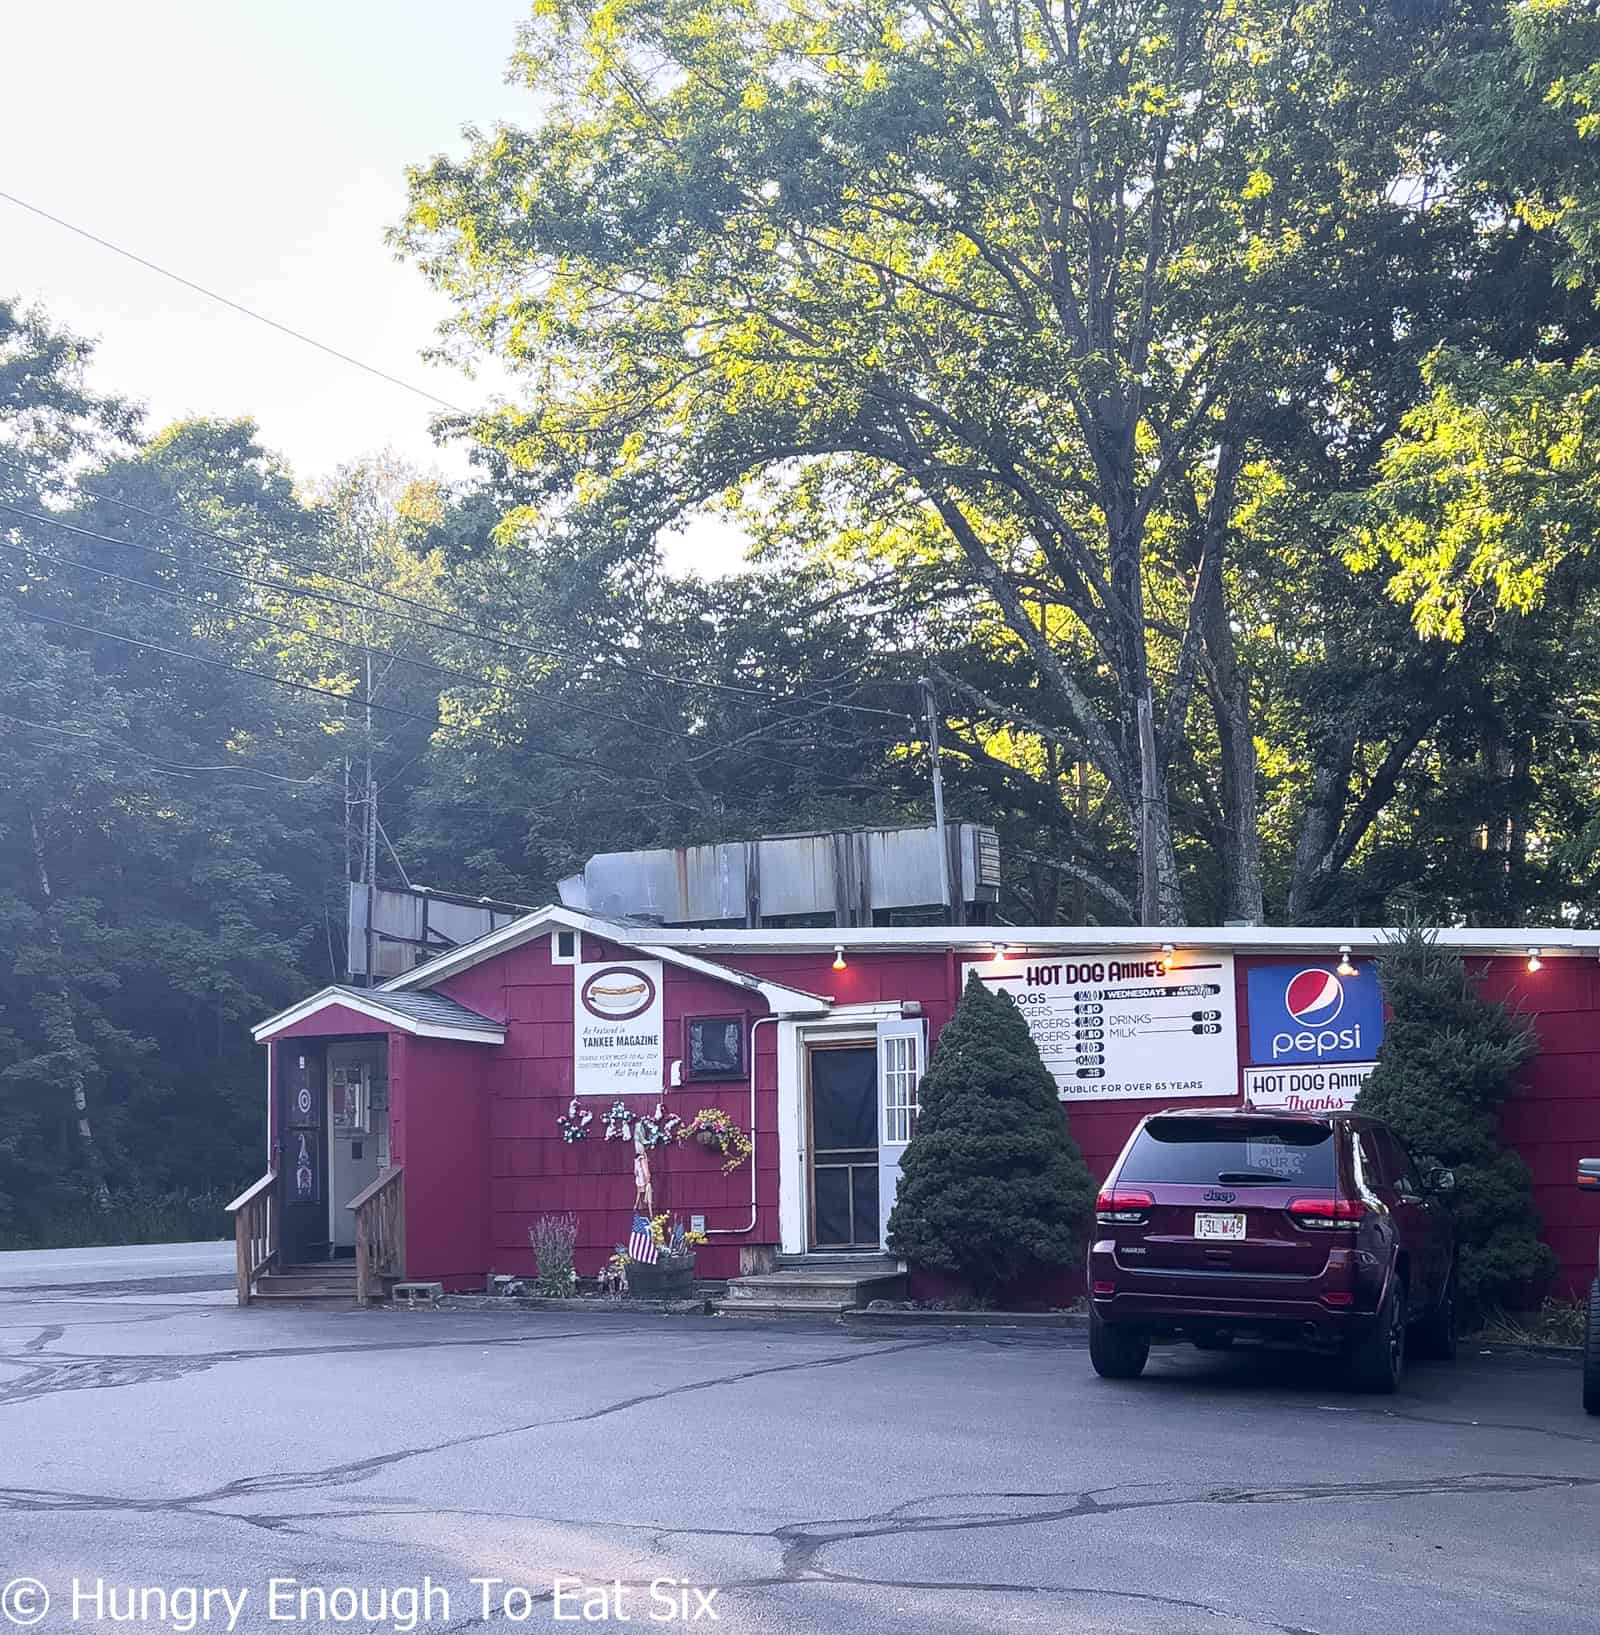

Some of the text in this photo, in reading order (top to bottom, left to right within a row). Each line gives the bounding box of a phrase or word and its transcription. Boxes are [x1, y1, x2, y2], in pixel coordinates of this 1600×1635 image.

[1026, 965, 1062, 987] HOT
[1066, 963, 1104, 985] DOG
[1109, 1013, 1152, 1026] DRINKS
[1109, 1027, 1137, 1039] MILK
[582, 1034, 659, 1048] YANKEE MAGAZINE
[1272, 1024, 1361, 1059] pepsi
[1063, 1080, 1203, 1094] PUBLIC FOR OVER 65 YEARS
[1253, 1075, 1286, 1094] HOT
[1290, 1073, 1325, 1092] DOG
[1284, 1094, 1345, 1111] Thanks
[1203, 1190, 1236, 1204] Jeep
